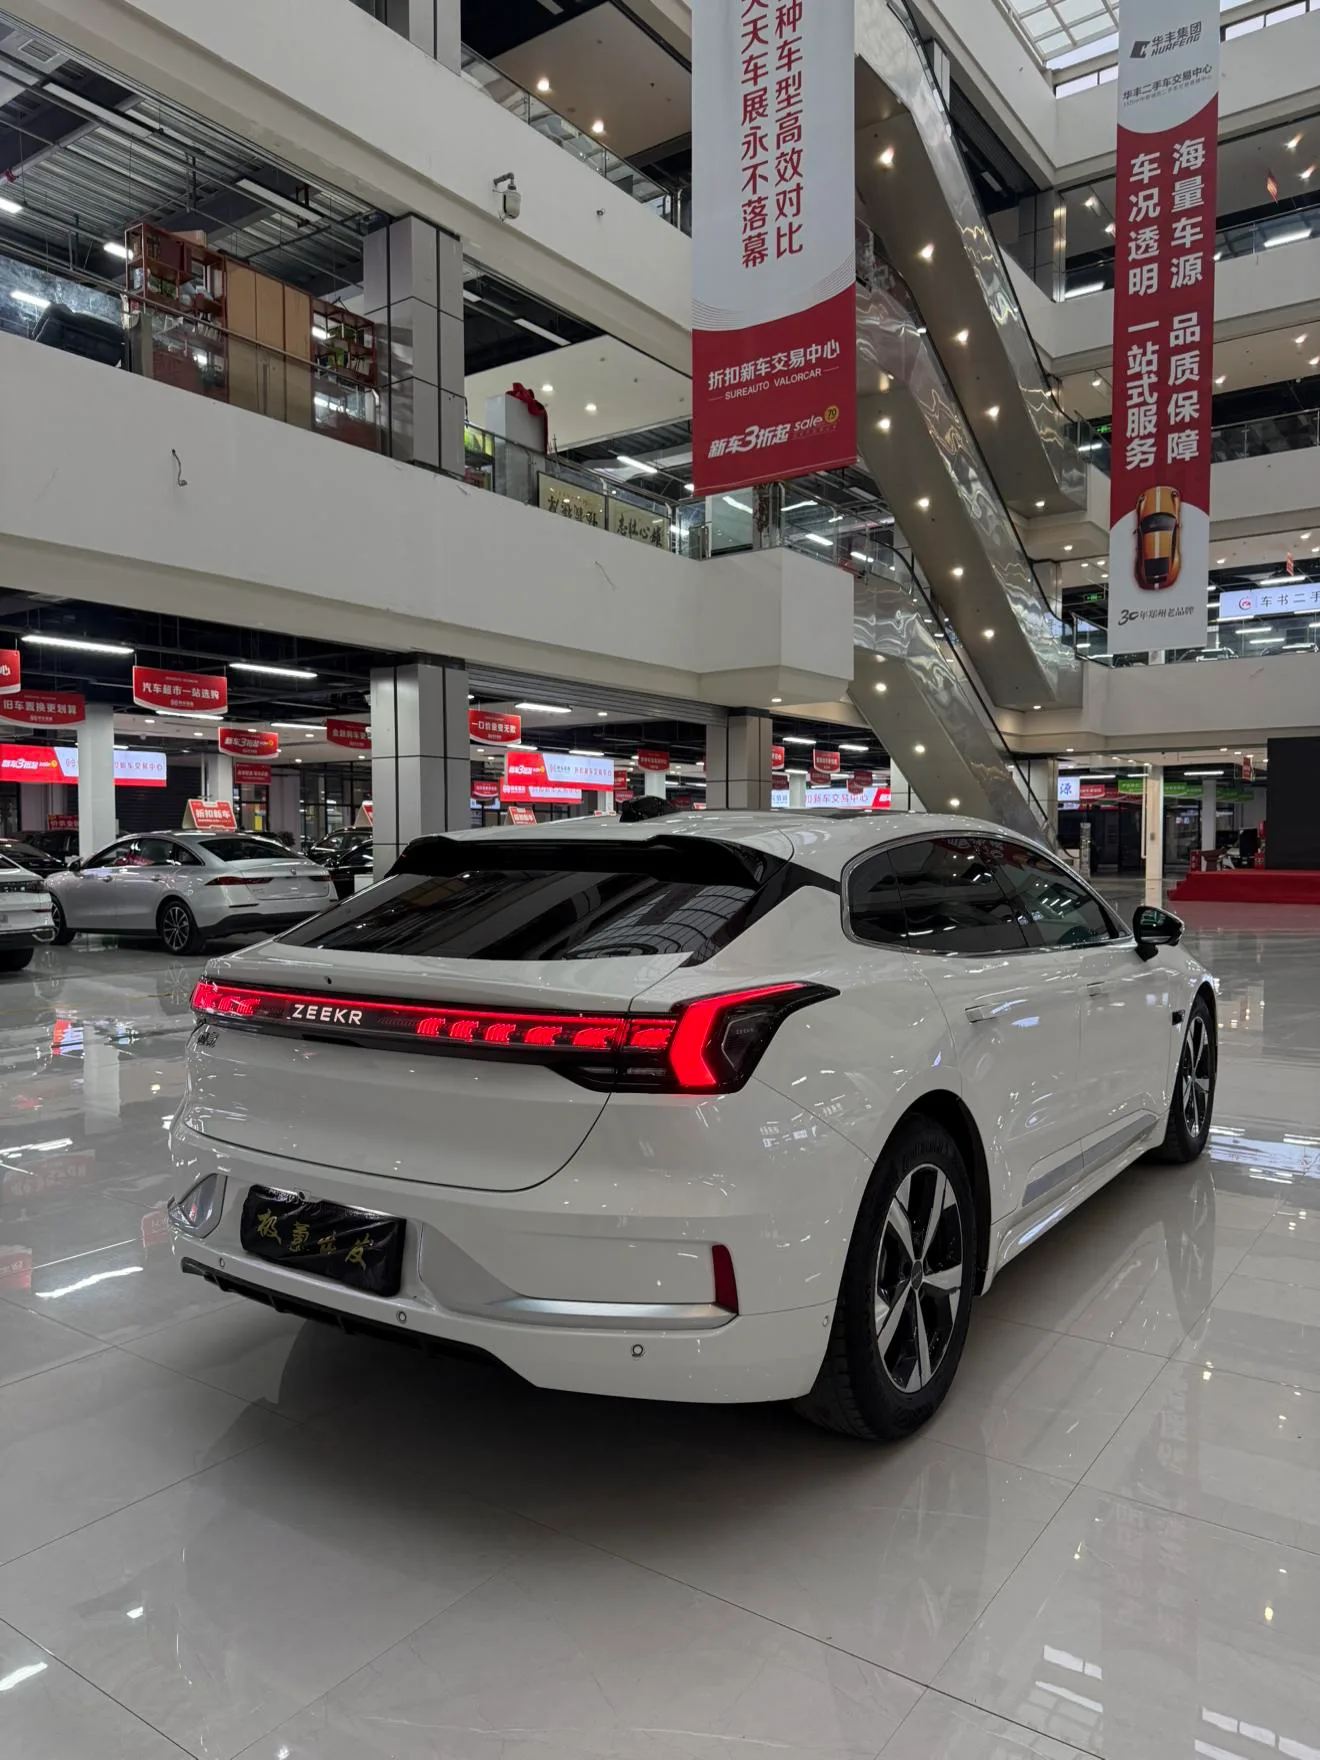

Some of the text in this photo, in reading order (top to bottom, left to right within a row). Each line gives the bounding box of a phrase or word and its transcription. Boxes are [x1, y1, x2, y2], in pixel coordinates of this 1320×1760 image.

[1151, 21, 1202, 47] 华丰集团
[1123, 64, 1212, 100] 华丰二手车交易中心
[1128, 152, 1161, 296] 车况透明
[1170, 137, 1206, 289] 海量车源
[708, 339, 840, 391] 折扣新车交易中心
[725, 368, 822, 400] SUREAUTO VALORCAR
[1126, 320, 1159, 471] 一站式服务
[1167, 312, 1200, 464] 品质保障
[708, 425, 791, 459] 新车3折起
[291, 1003, 363, 1025] ZEEKR
